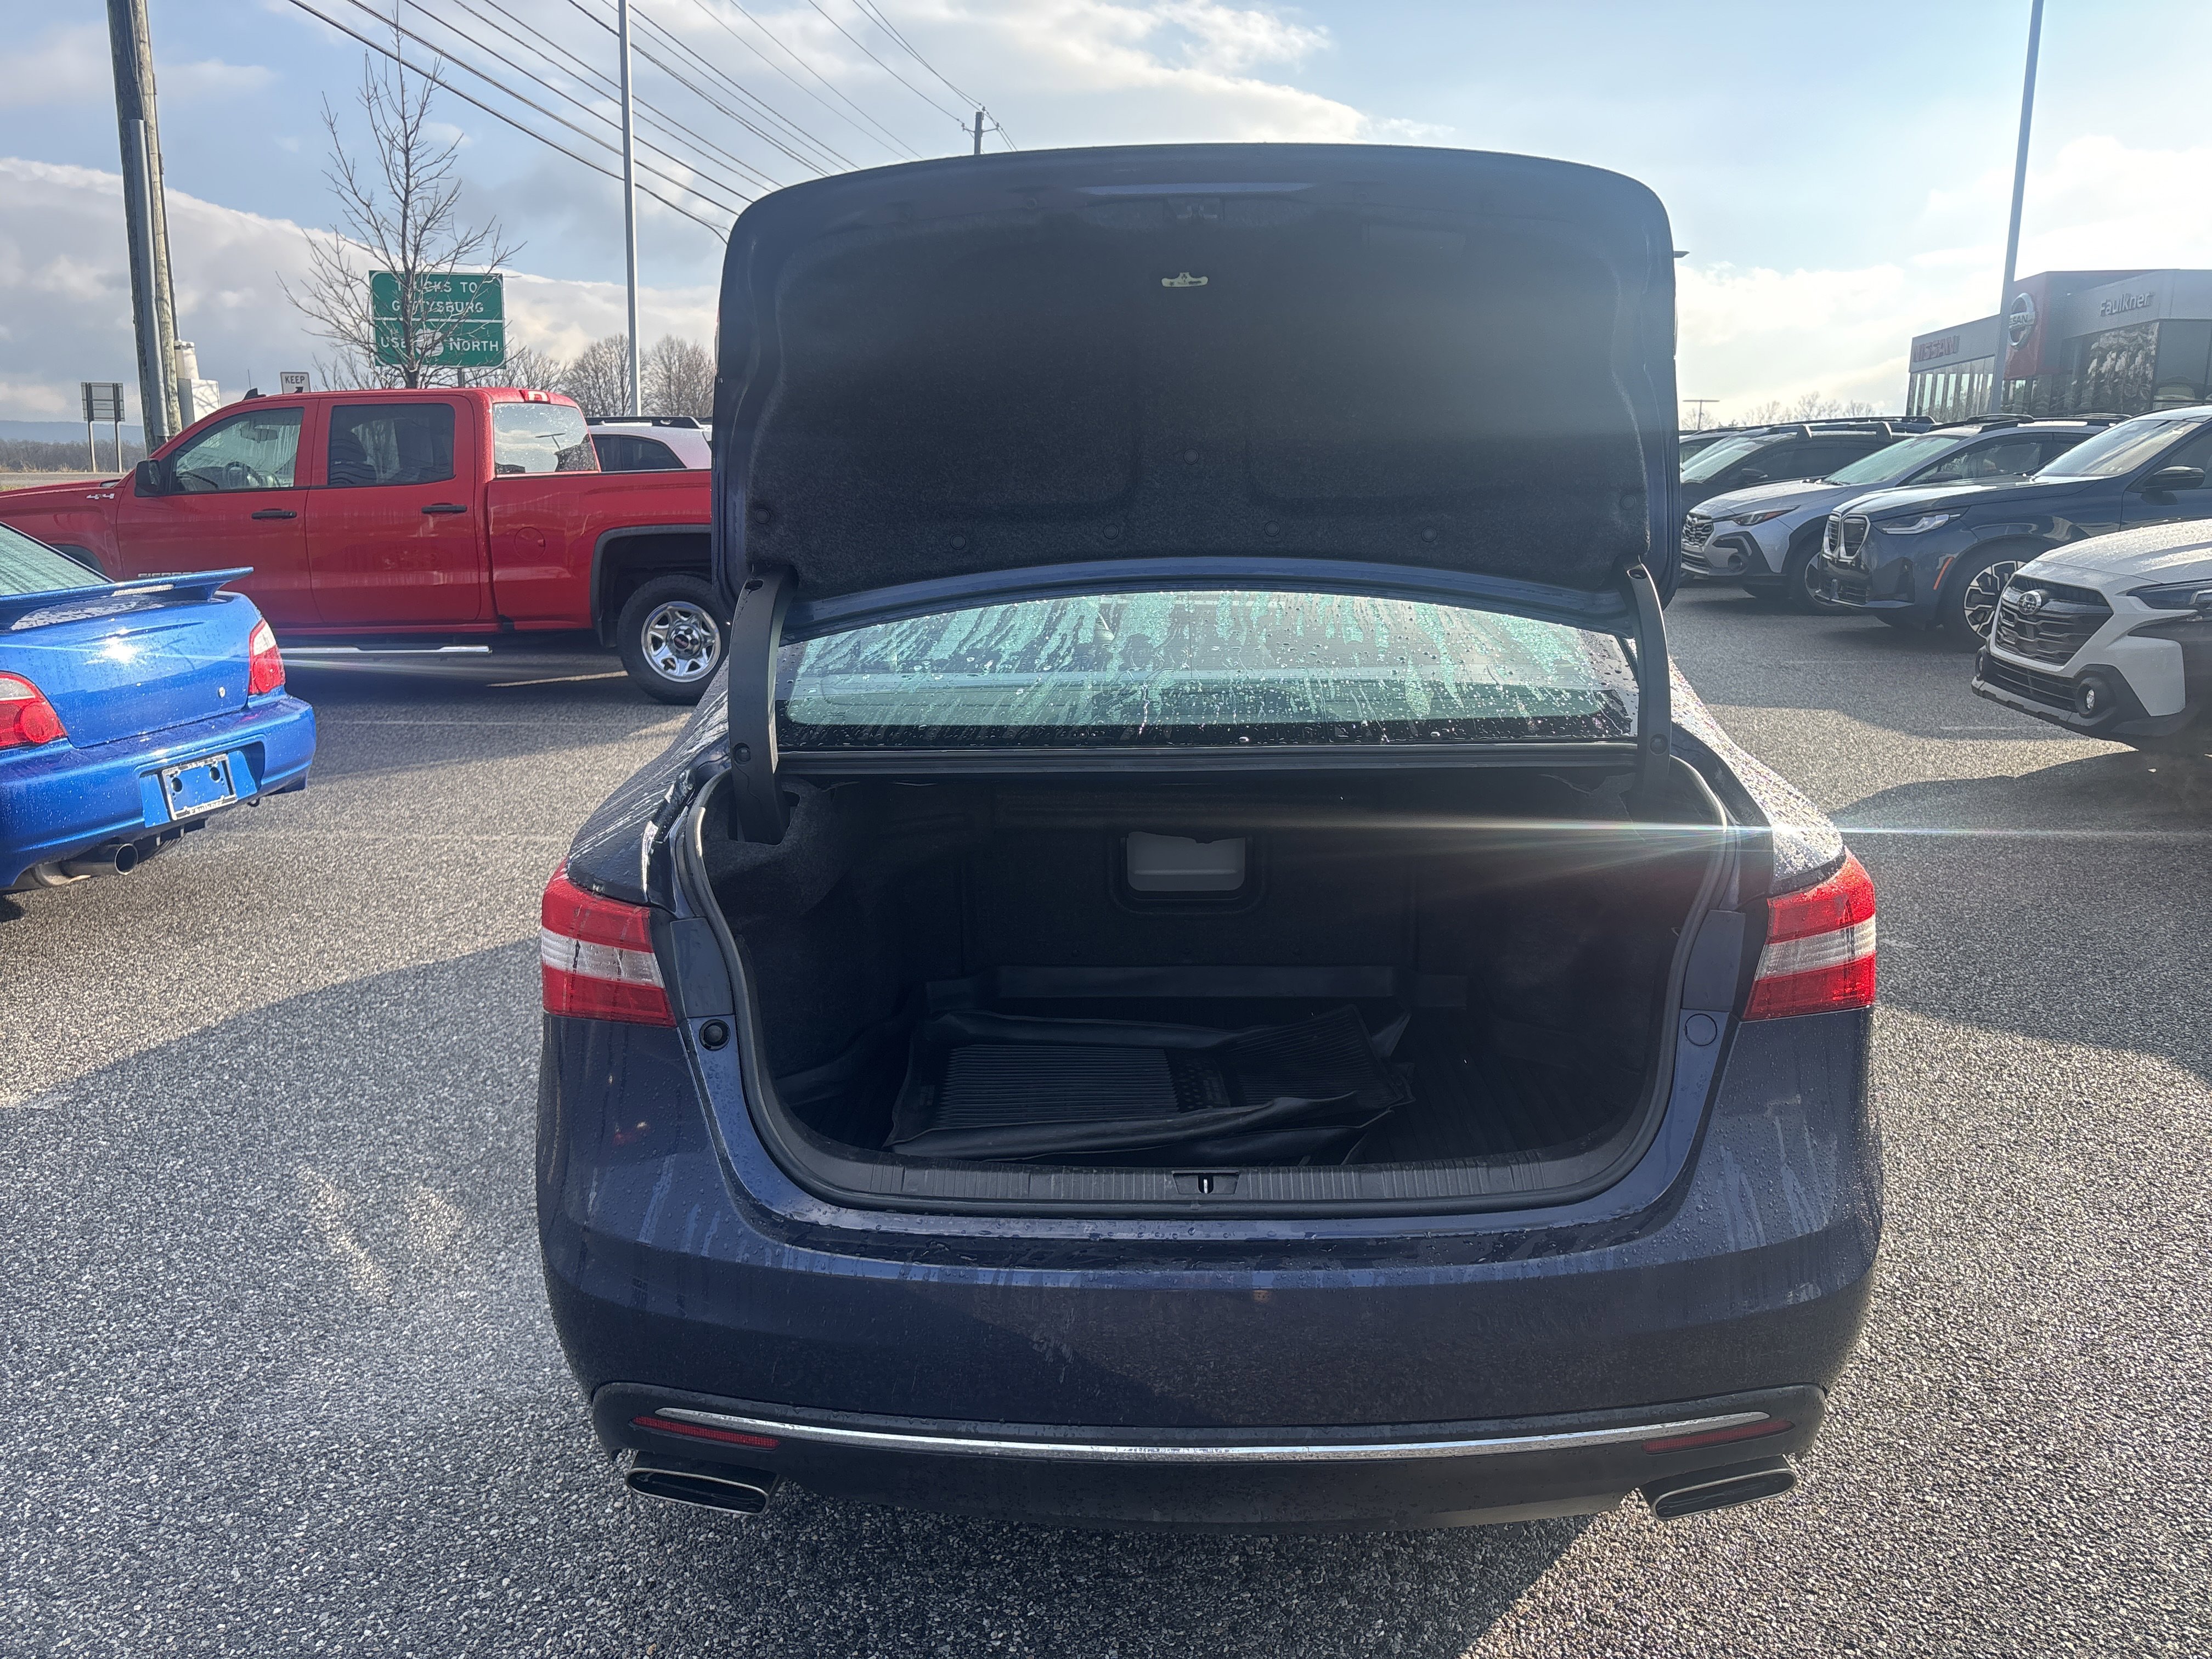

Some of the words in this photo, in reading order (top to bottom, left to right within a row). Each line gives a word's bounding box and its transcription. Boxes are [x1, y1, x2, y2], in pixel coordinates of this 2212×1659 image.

[460, 281, 478, 293] TO
[2099, 292, 2151, 317] Faulkner
[449, 337, 498, 351] NORTH
[1912, 336, 1958, 363] NISSAN
[285, 376, 305, 384] KEEP
